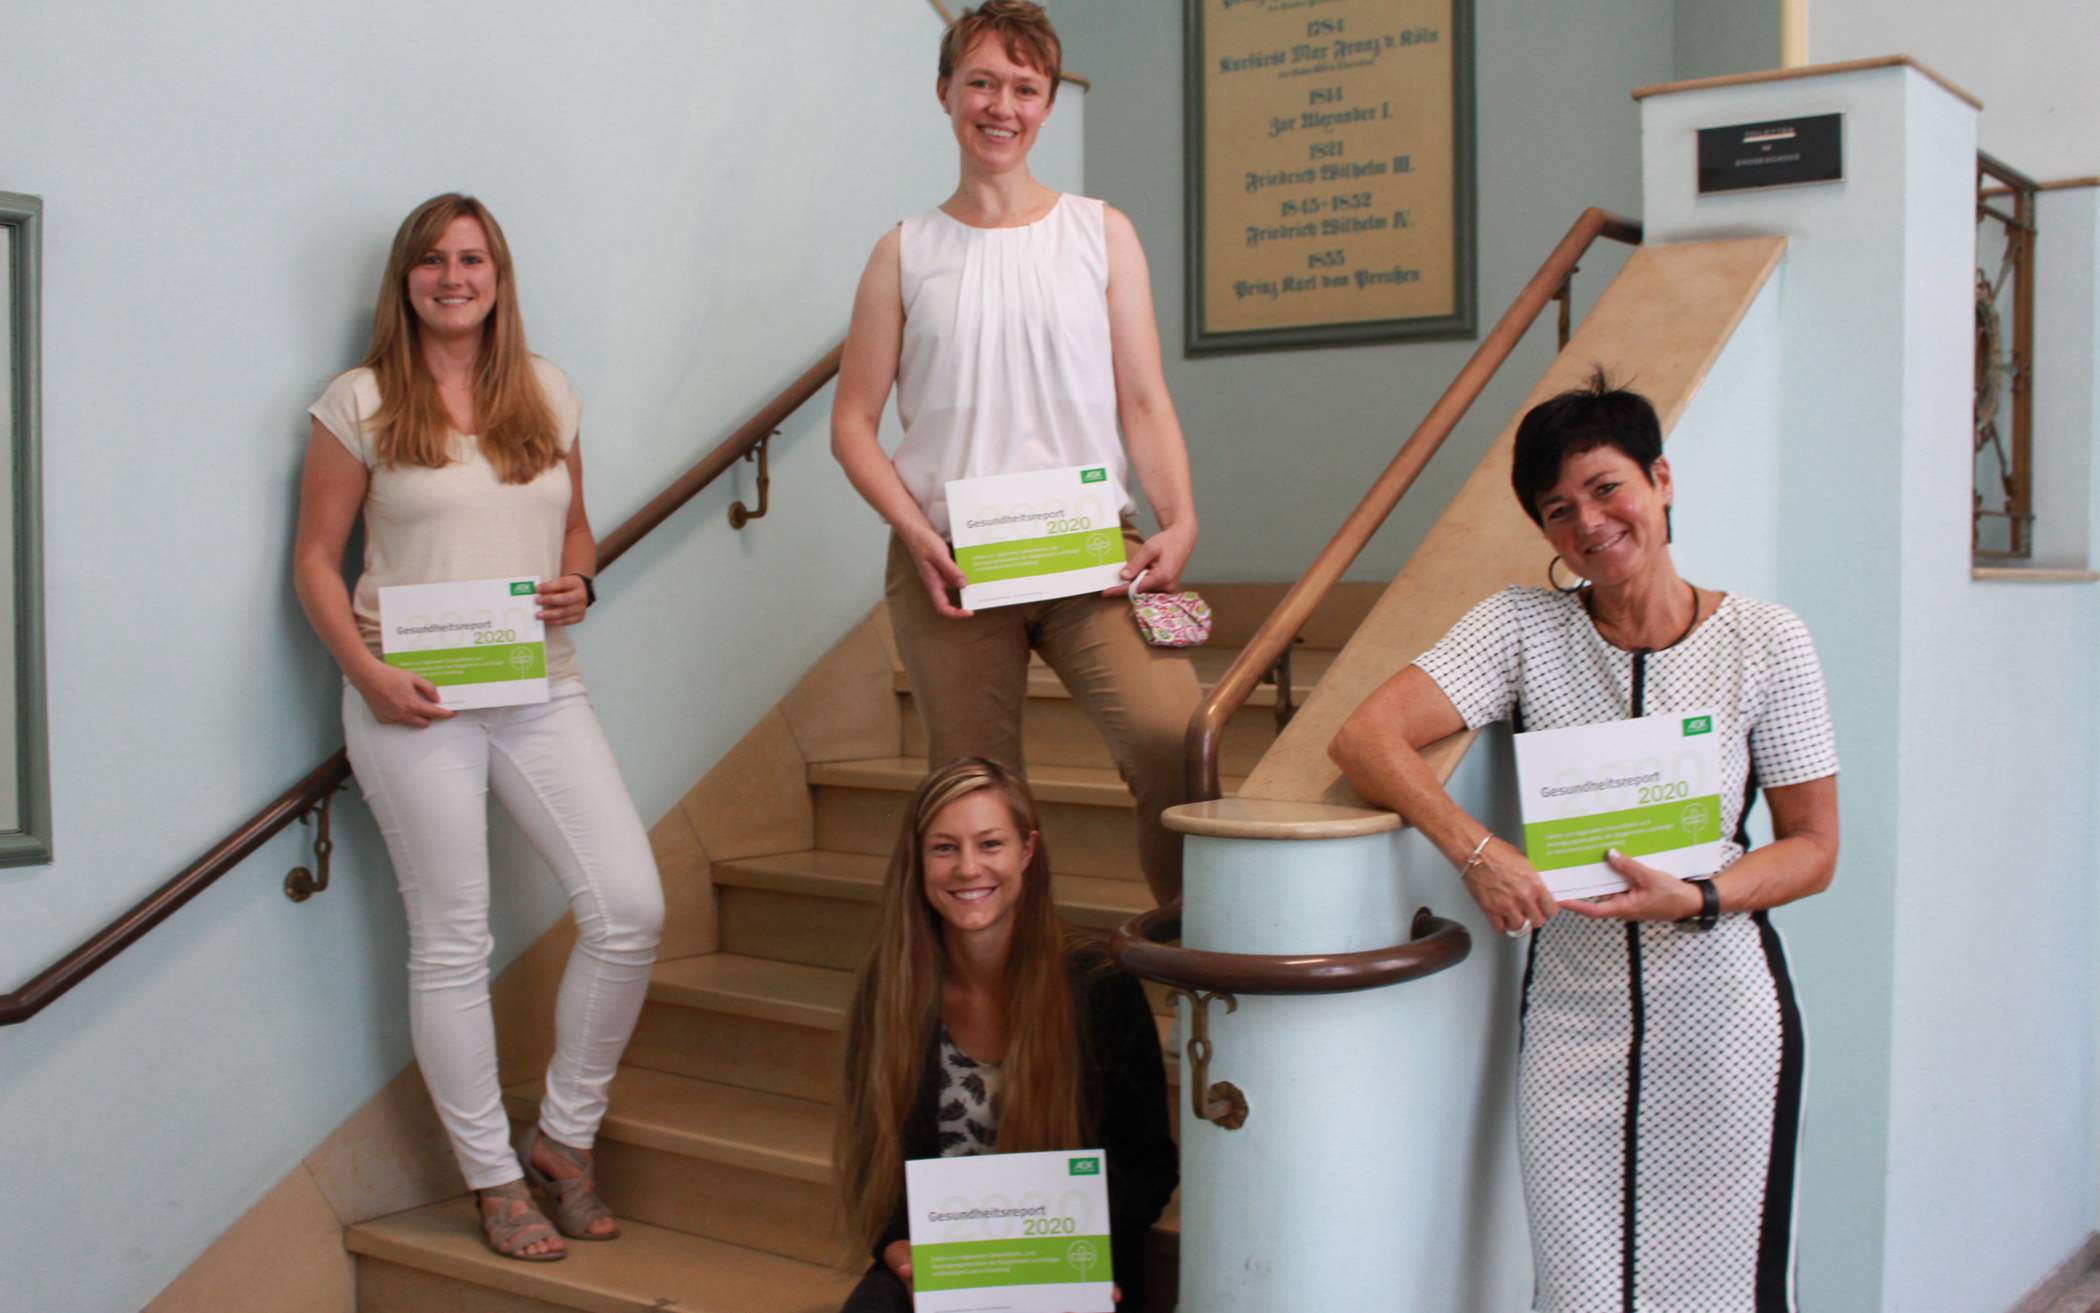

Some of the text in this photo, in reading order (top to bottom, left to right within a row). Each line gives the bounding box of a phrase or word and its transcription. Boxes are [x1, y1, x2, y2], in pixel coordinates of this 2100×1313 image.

[1333, 38, 1382, 60] Franz
[1245, 167, 1316, 193] Friedrich
[1320, 159, 1387, 181] Wilhelm
[1246, 220, 1317, 247] Friedrich
[1321, 214, 1387, 237] Wilhelm
[1234, 279, 1279, 300] Prinz
[1282, 275, 1317, 295] Karl
[966, 509, 1065, 529] Gesundheitsreport
[1047, 516, 1091, 535] 2020
[396, 620, 492, 635] Gesundheitsreport
[473, 629, 516, 645] 2020
[1540, 771, 1661, 798] Gesundheitsreport
[1637, 780, 1689, 805] 2020
[928, 1205, 1047, 1223] Gesundheitsreport
[1023, 1216, 1076, 1235] 2020
